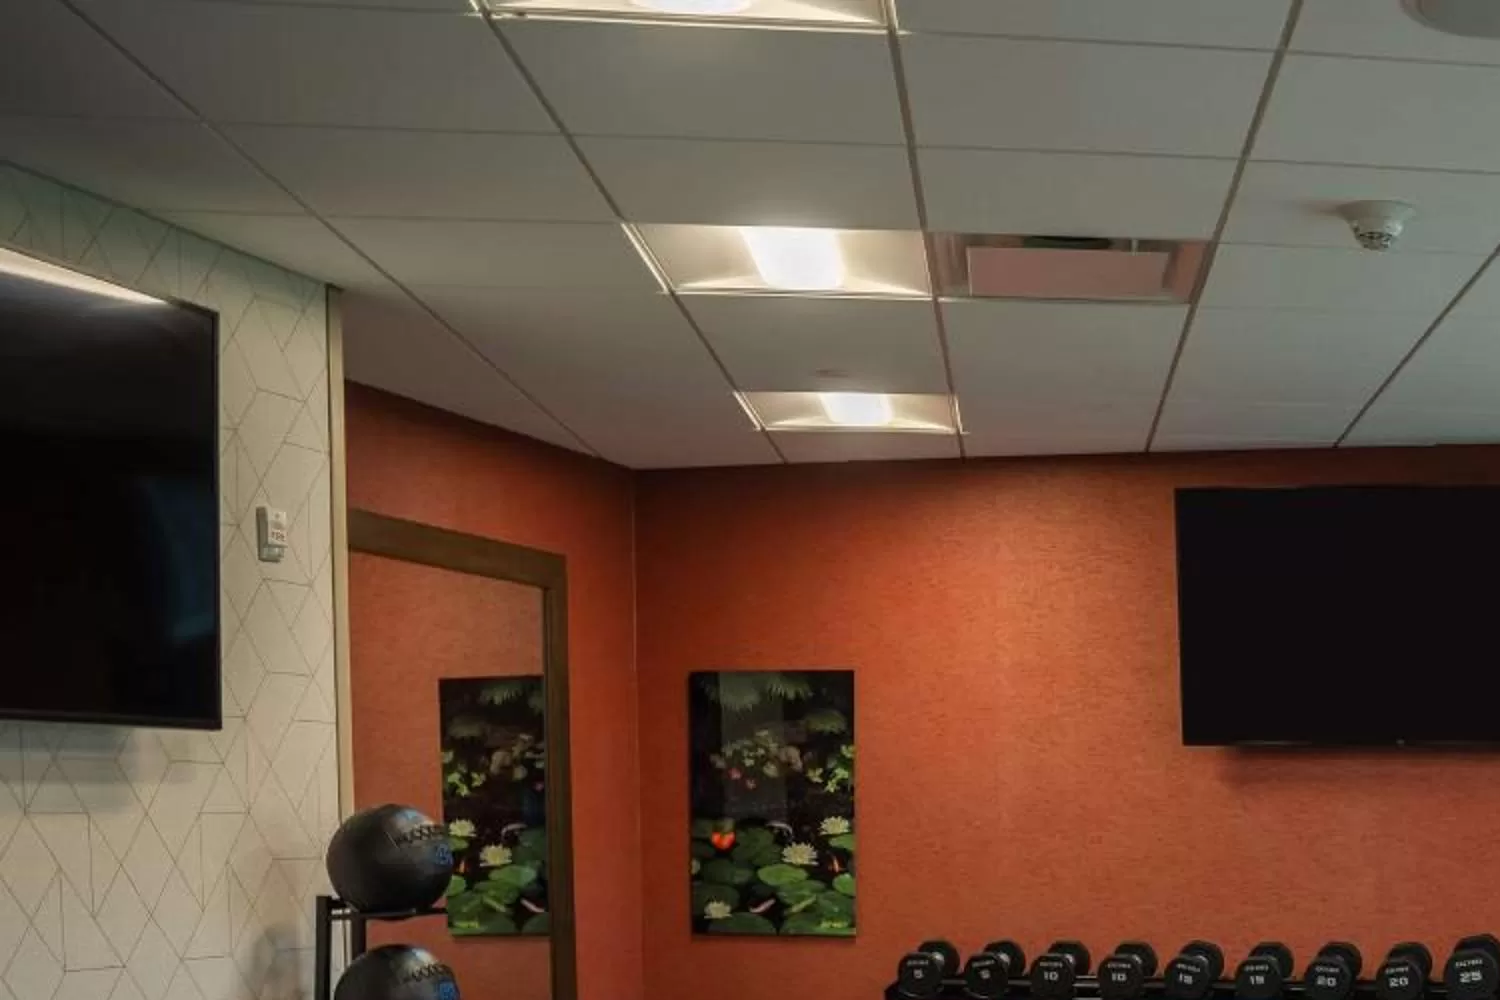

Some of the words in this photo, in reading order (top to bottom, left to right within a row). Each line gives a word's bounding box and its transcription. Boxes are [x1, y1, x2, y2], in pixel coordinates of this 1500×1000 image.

[1044, 971, 1059, 981] 10
[1111, 972, 1128, 982] 10
[1316, 976, 1337, 987] 20
[1389, 976, 1409, 987] 20
[1460, 970, 1482, 983] 25
